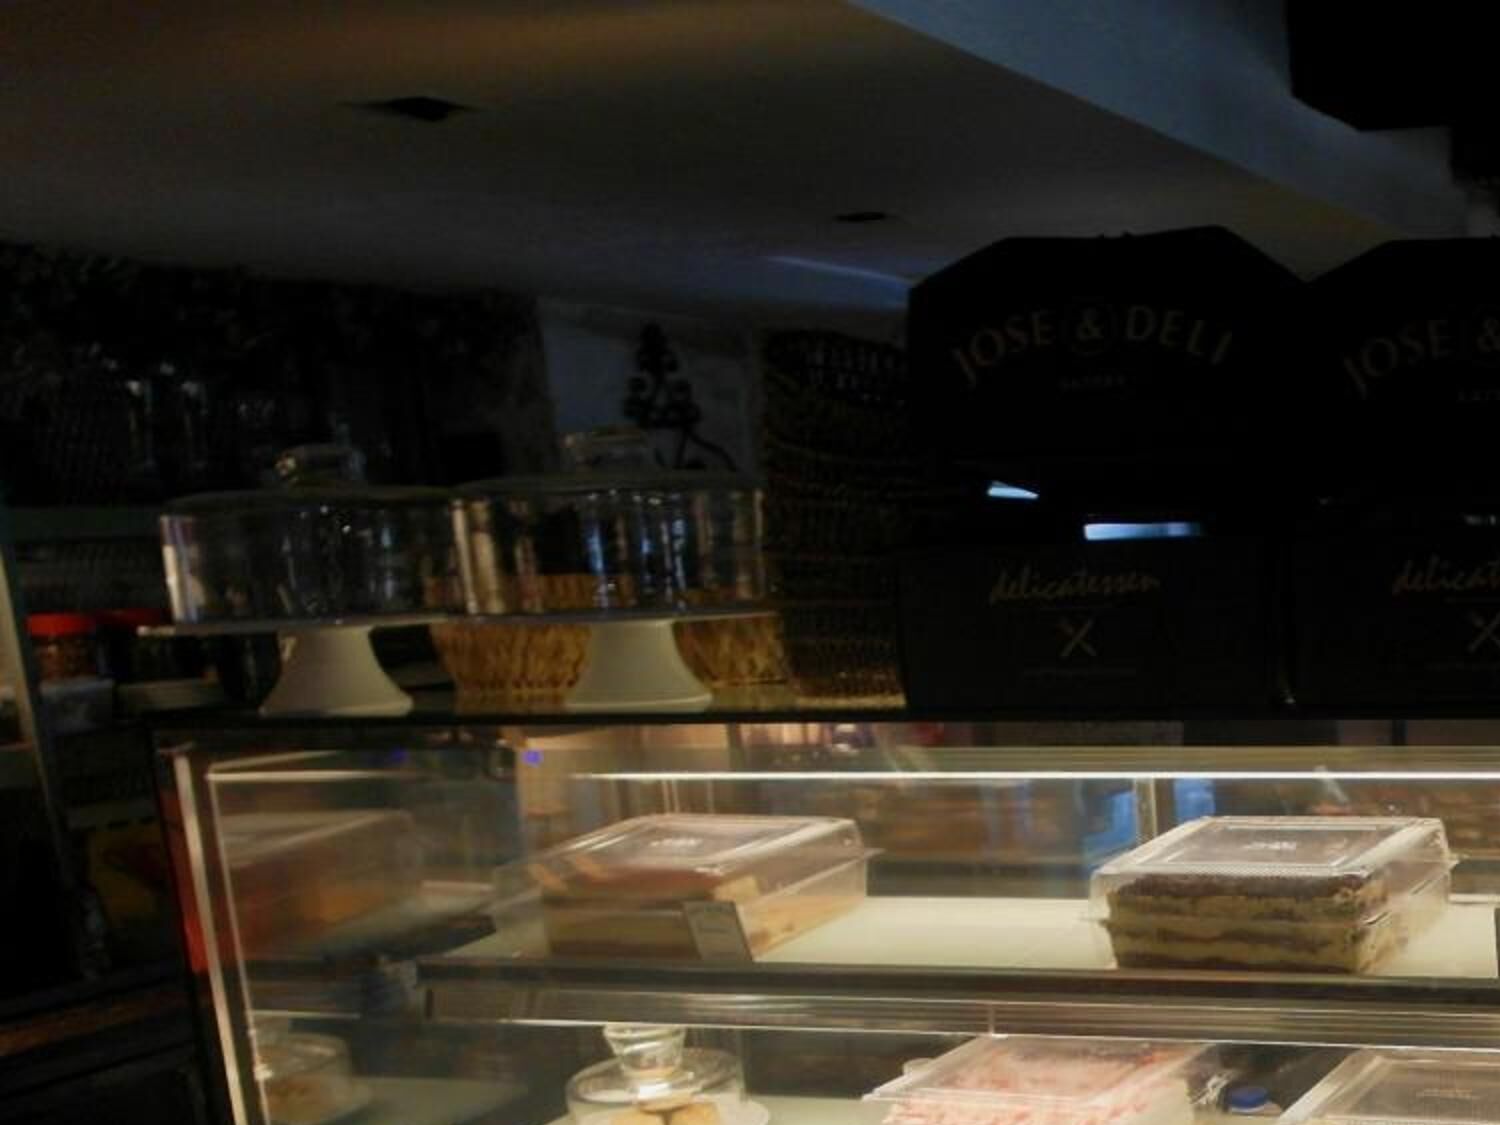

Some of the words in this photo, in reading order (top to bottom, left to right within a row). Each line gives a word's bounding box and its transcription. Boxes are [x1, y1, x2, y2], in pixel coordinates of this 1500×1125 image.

[949, 307, 1057, 392] JOSE
[1075, 306, 1105, 342] &
[1124, 303, 1234, 367] DELI
[1342, 318, 1456, 400] JOSE
